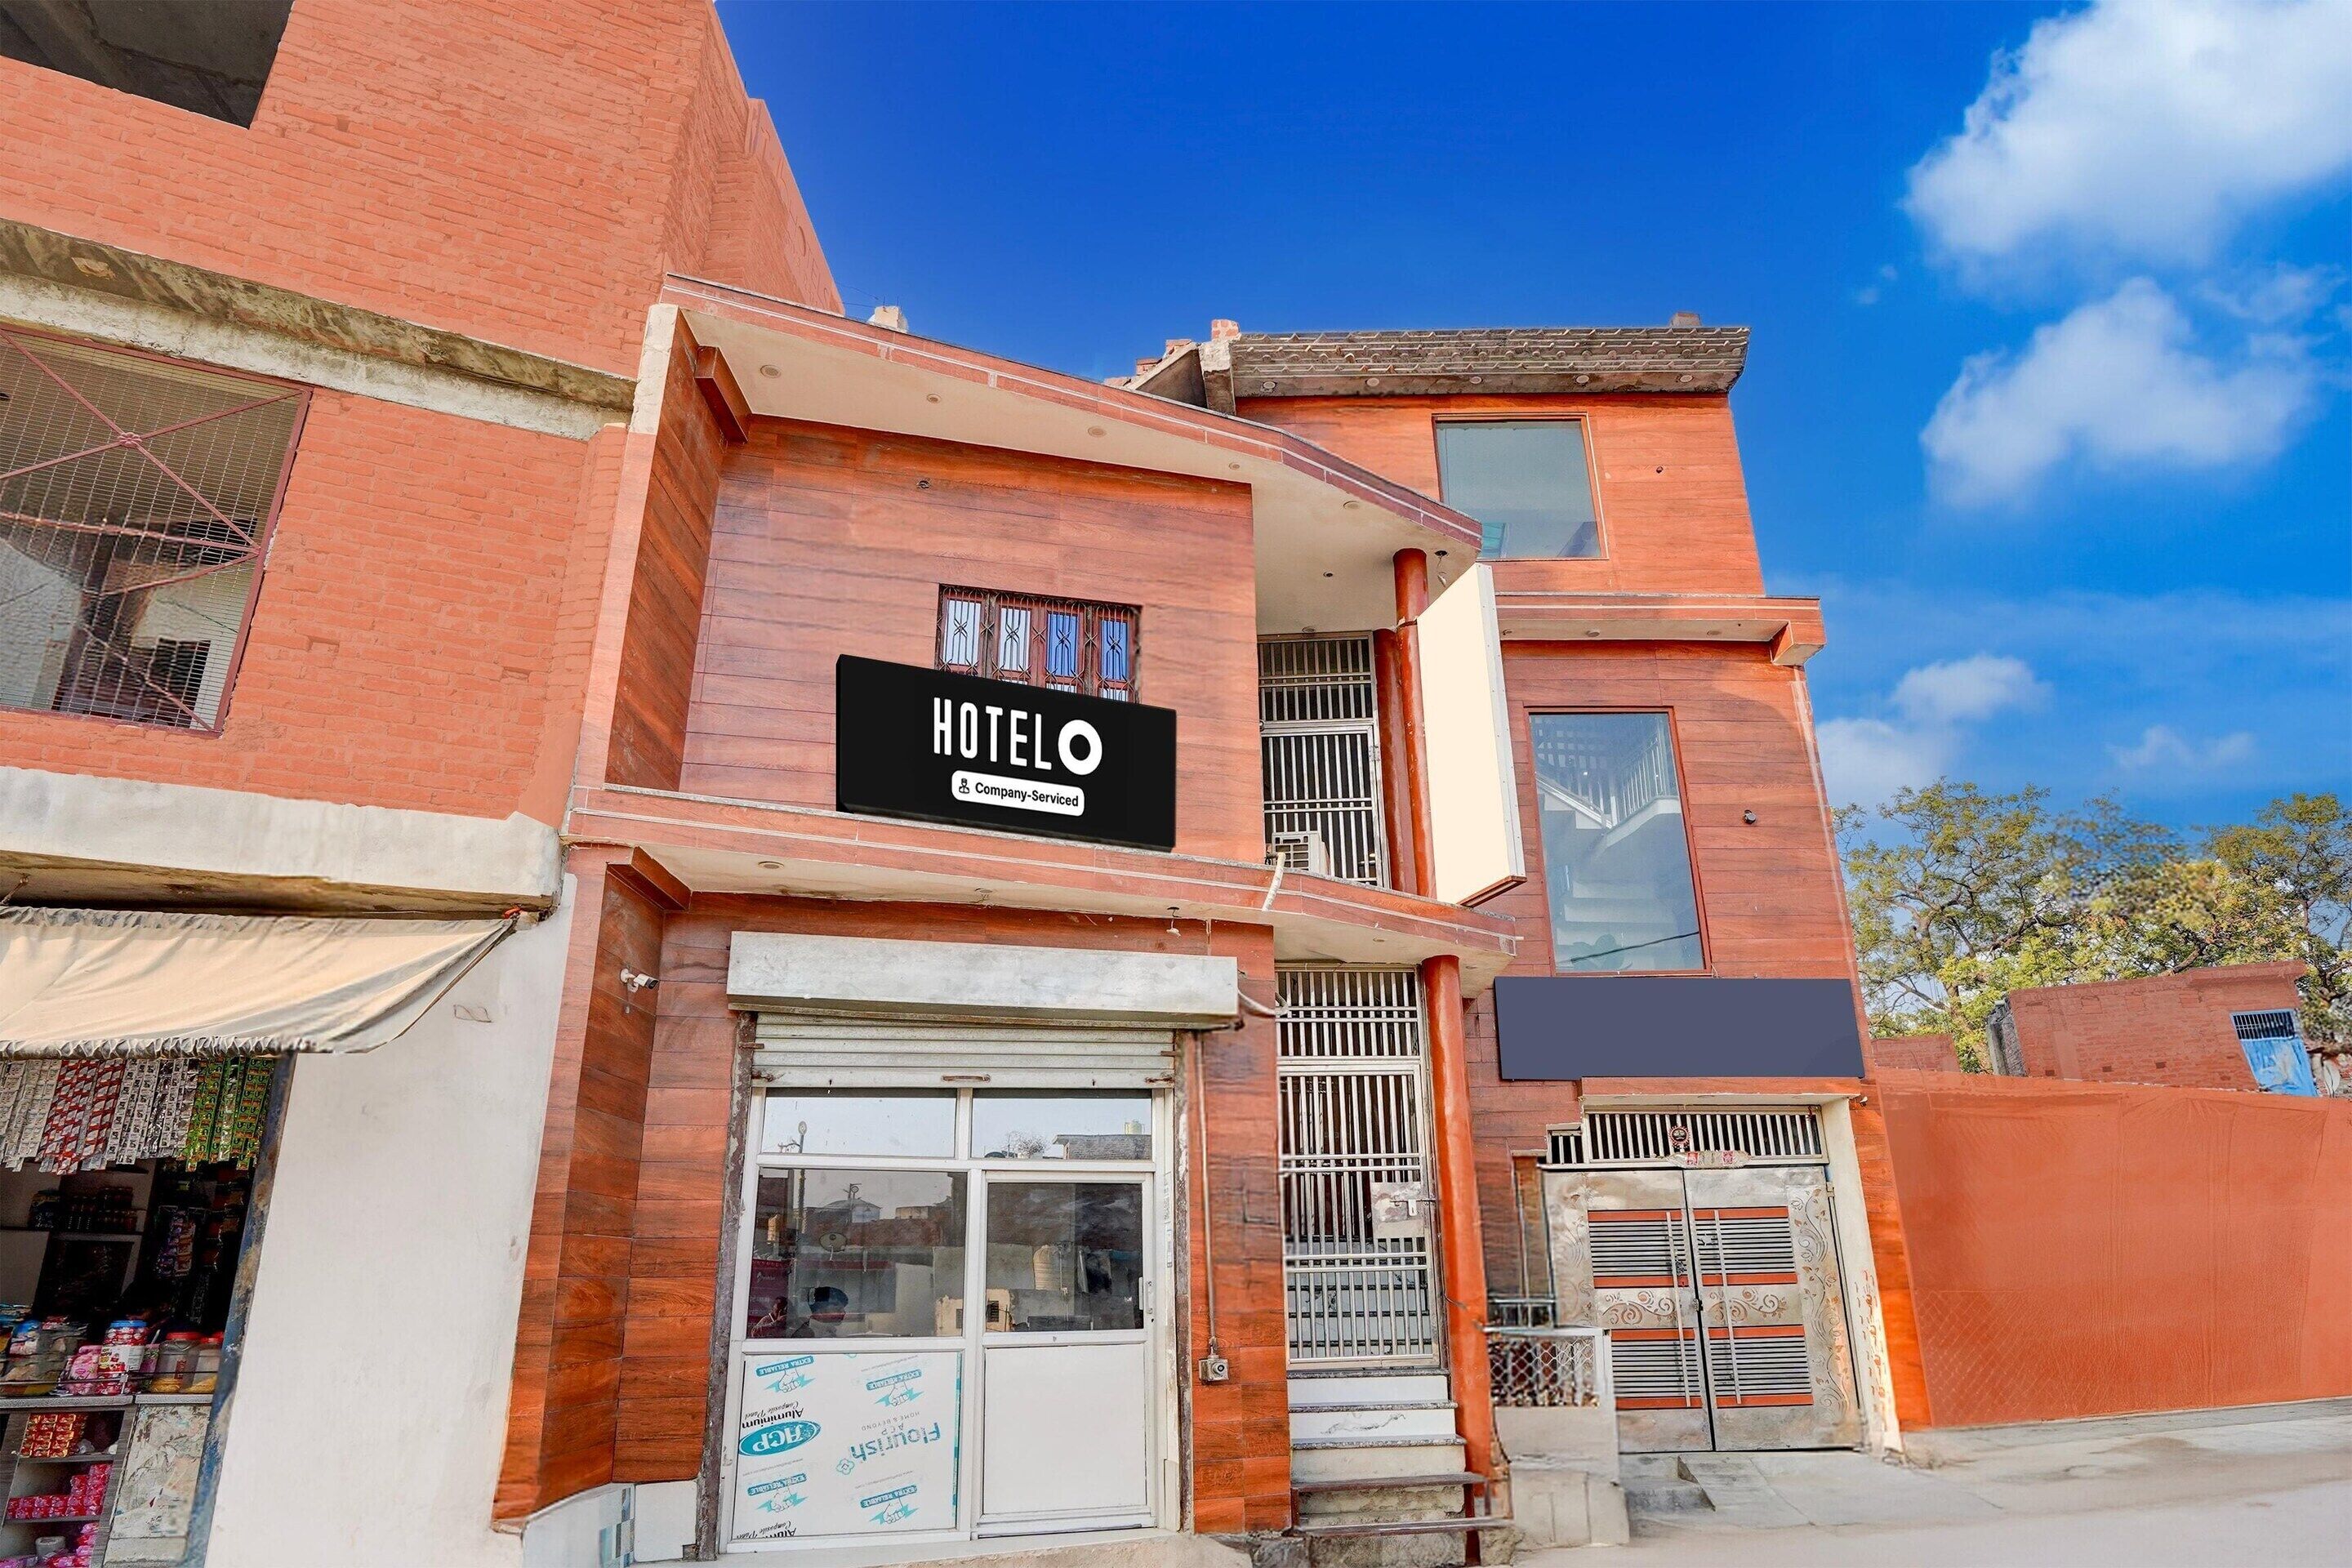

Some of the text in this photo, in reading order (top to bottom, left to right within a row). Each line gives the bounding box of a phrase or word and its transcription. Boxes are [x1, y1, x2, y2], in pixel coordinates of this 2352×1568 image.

[933, 697, 1052, 770] HOTEL
[975, 782, 1079, 808] Company-Serviced
[759, 1357, 812, 1375] EXTRA RELIABLE
[742, 1408, 804, 1429] Aluminium
[752, 1424, 804, 1452] ACP
[850, 1422, 941, 1462] Flourish
